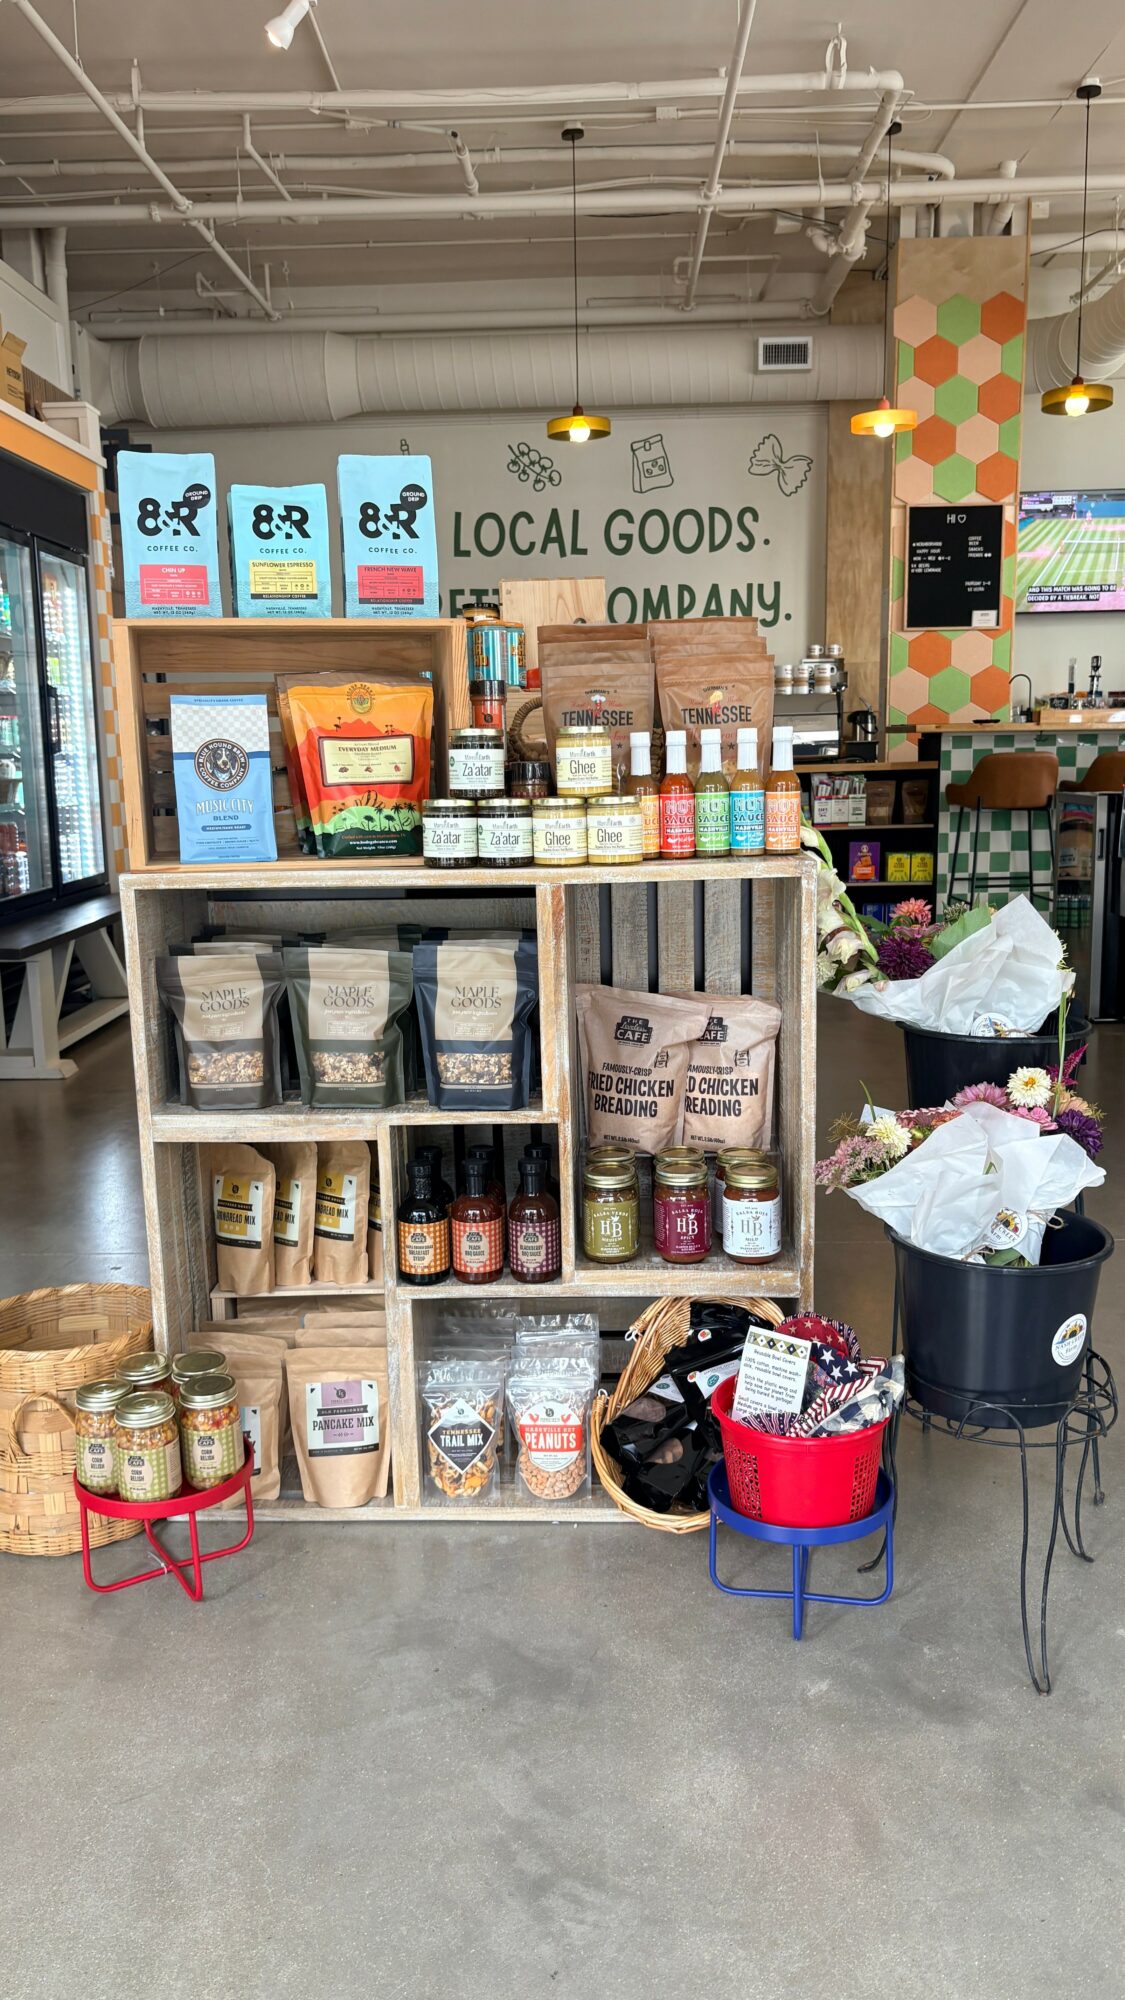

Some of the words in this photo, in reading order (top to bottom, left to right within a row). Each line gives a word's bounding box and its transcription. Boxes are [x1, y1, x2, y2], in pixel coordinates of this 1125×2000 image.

[946, 514, 956, 524] HI
[453, 508, 588, 558] LOCAL
[604, 506, 770, 556] GOODS.
[368, 546, 398, 554] COFFEE
[606, 581, 792, 628] OMPANY.
[562, 710, 634, 726] TENNESSEE
[681, 706, 752, 724] TENNESSEE
[198, 748, 209, 763] BLUE
[208, 742, 232, 750] HOUND
[233, 747, 246, 763] BREW
[462, 763, 492, 776] Za'atar
[570, 760, 596, 774] Ghee
[199, 768, 220, 788] COFFEE
[220, 767, 244, 788] COMPANY
[196, 800, 229, 816] MUSIC
[230, 799, 254, 815] CITY
[664, 800, 695, 815] HOT
[698, 799, 728, 813] HOT
[734, 798, 764, 812] HOT
[767, 799, 798, 814] HOT
[698, 814, 729, 822] SAUCE
[734, 814, 764, 822] SAUCE
[432, 830, 462, 844] Za'atar
[490, 832, 520, 846] Za'atar
[545, 832, 570, 846] Ghee
[596, 828, 622, 842] Ghee
[200, 988, 248, 1001] MAPLE
[328, 986, 372, 997] MAPLE
[454, 986, 500, 998] MAPLE
[200, 998, 250, 1013] GOODS
[324, 996, 375, 1008] GOODS
[450, 997, 502, 1009] GOODS
[616, 1030, 649, 1042] CAFE
[602, 1062, 652, 1076] FAMOUSLY-CRISP
[687, 1064, 734, 1075] AMOUSLY-CRISP
[588, 1071, 614, 1092] FRIED
[616, 1078, 674, 1098] CHICKEN
[700, 1077, 758, 1096] CHICKEN
[594, 1094, 658, 1118] BREADING
[244, 1214, 256, 1226] MIX
[284, 1213, 295, 1224] MIX
[336, 1208, 348, 1218] MIX
[782, 1357, 796, 1366] Covers
[312, 1418, 354, 1431] PANCAKE
[356, 1416, 374, 1428] MIX
[440, 1434, 464, 1447] TRAIL
[466, 1434, 484, 1446] MIX
[524, 1432, 576, 1449] PEANUTS
